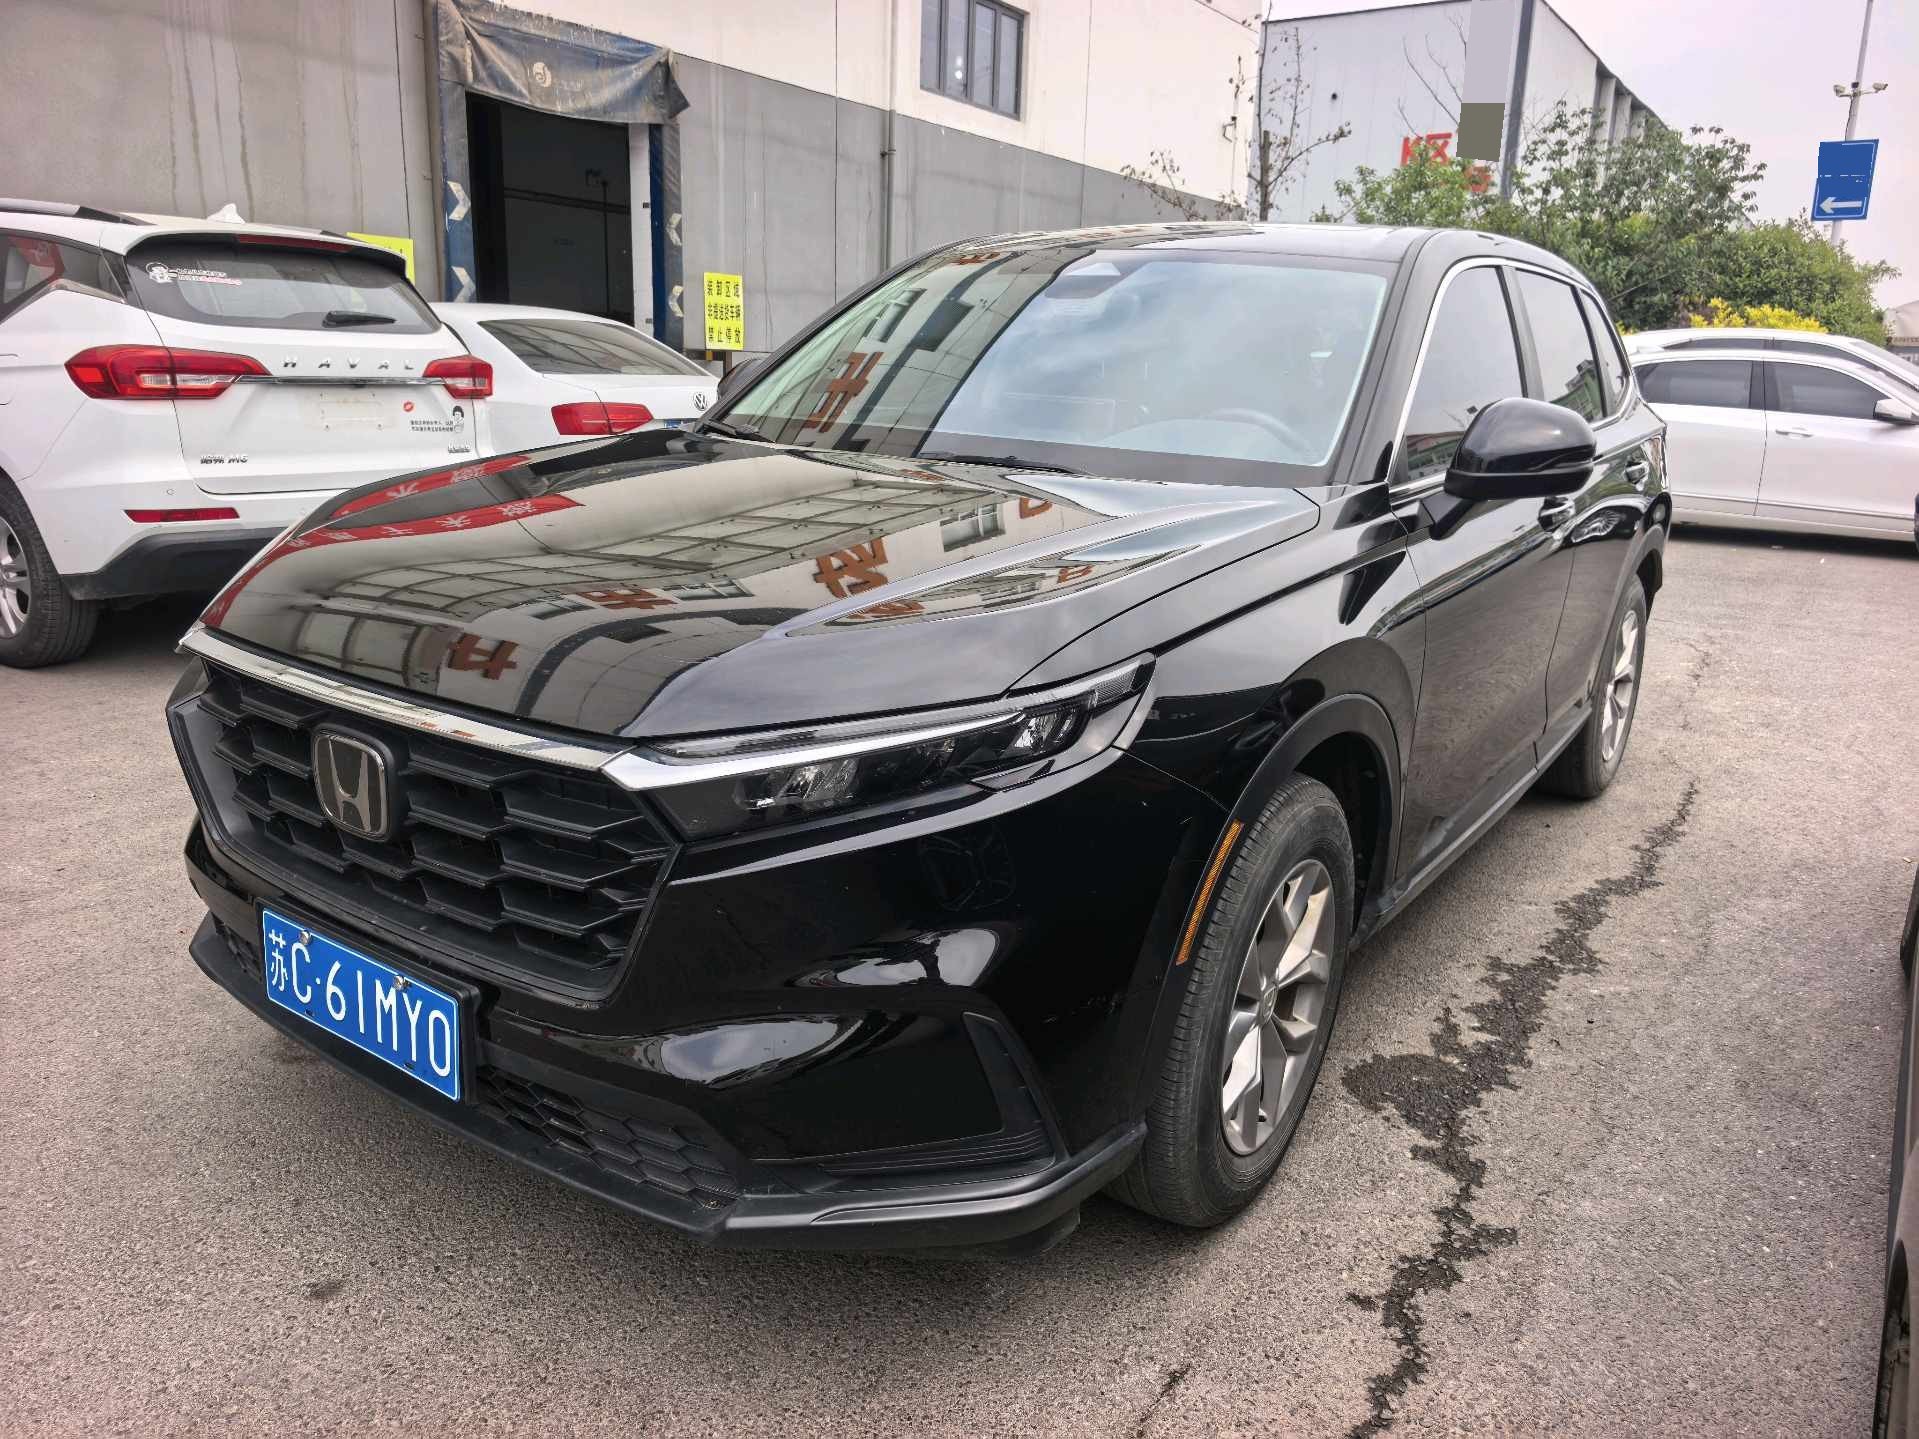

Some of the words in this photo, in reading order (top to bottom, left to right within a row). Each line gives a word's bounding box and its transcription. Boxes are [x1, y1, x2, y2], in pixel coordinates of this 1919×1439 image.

[708, 327, 741, 343] 禁止停放
[281, 355, 414, 370] HAVAL
[269, 929, 451, 1077] 苏C·61MY0
